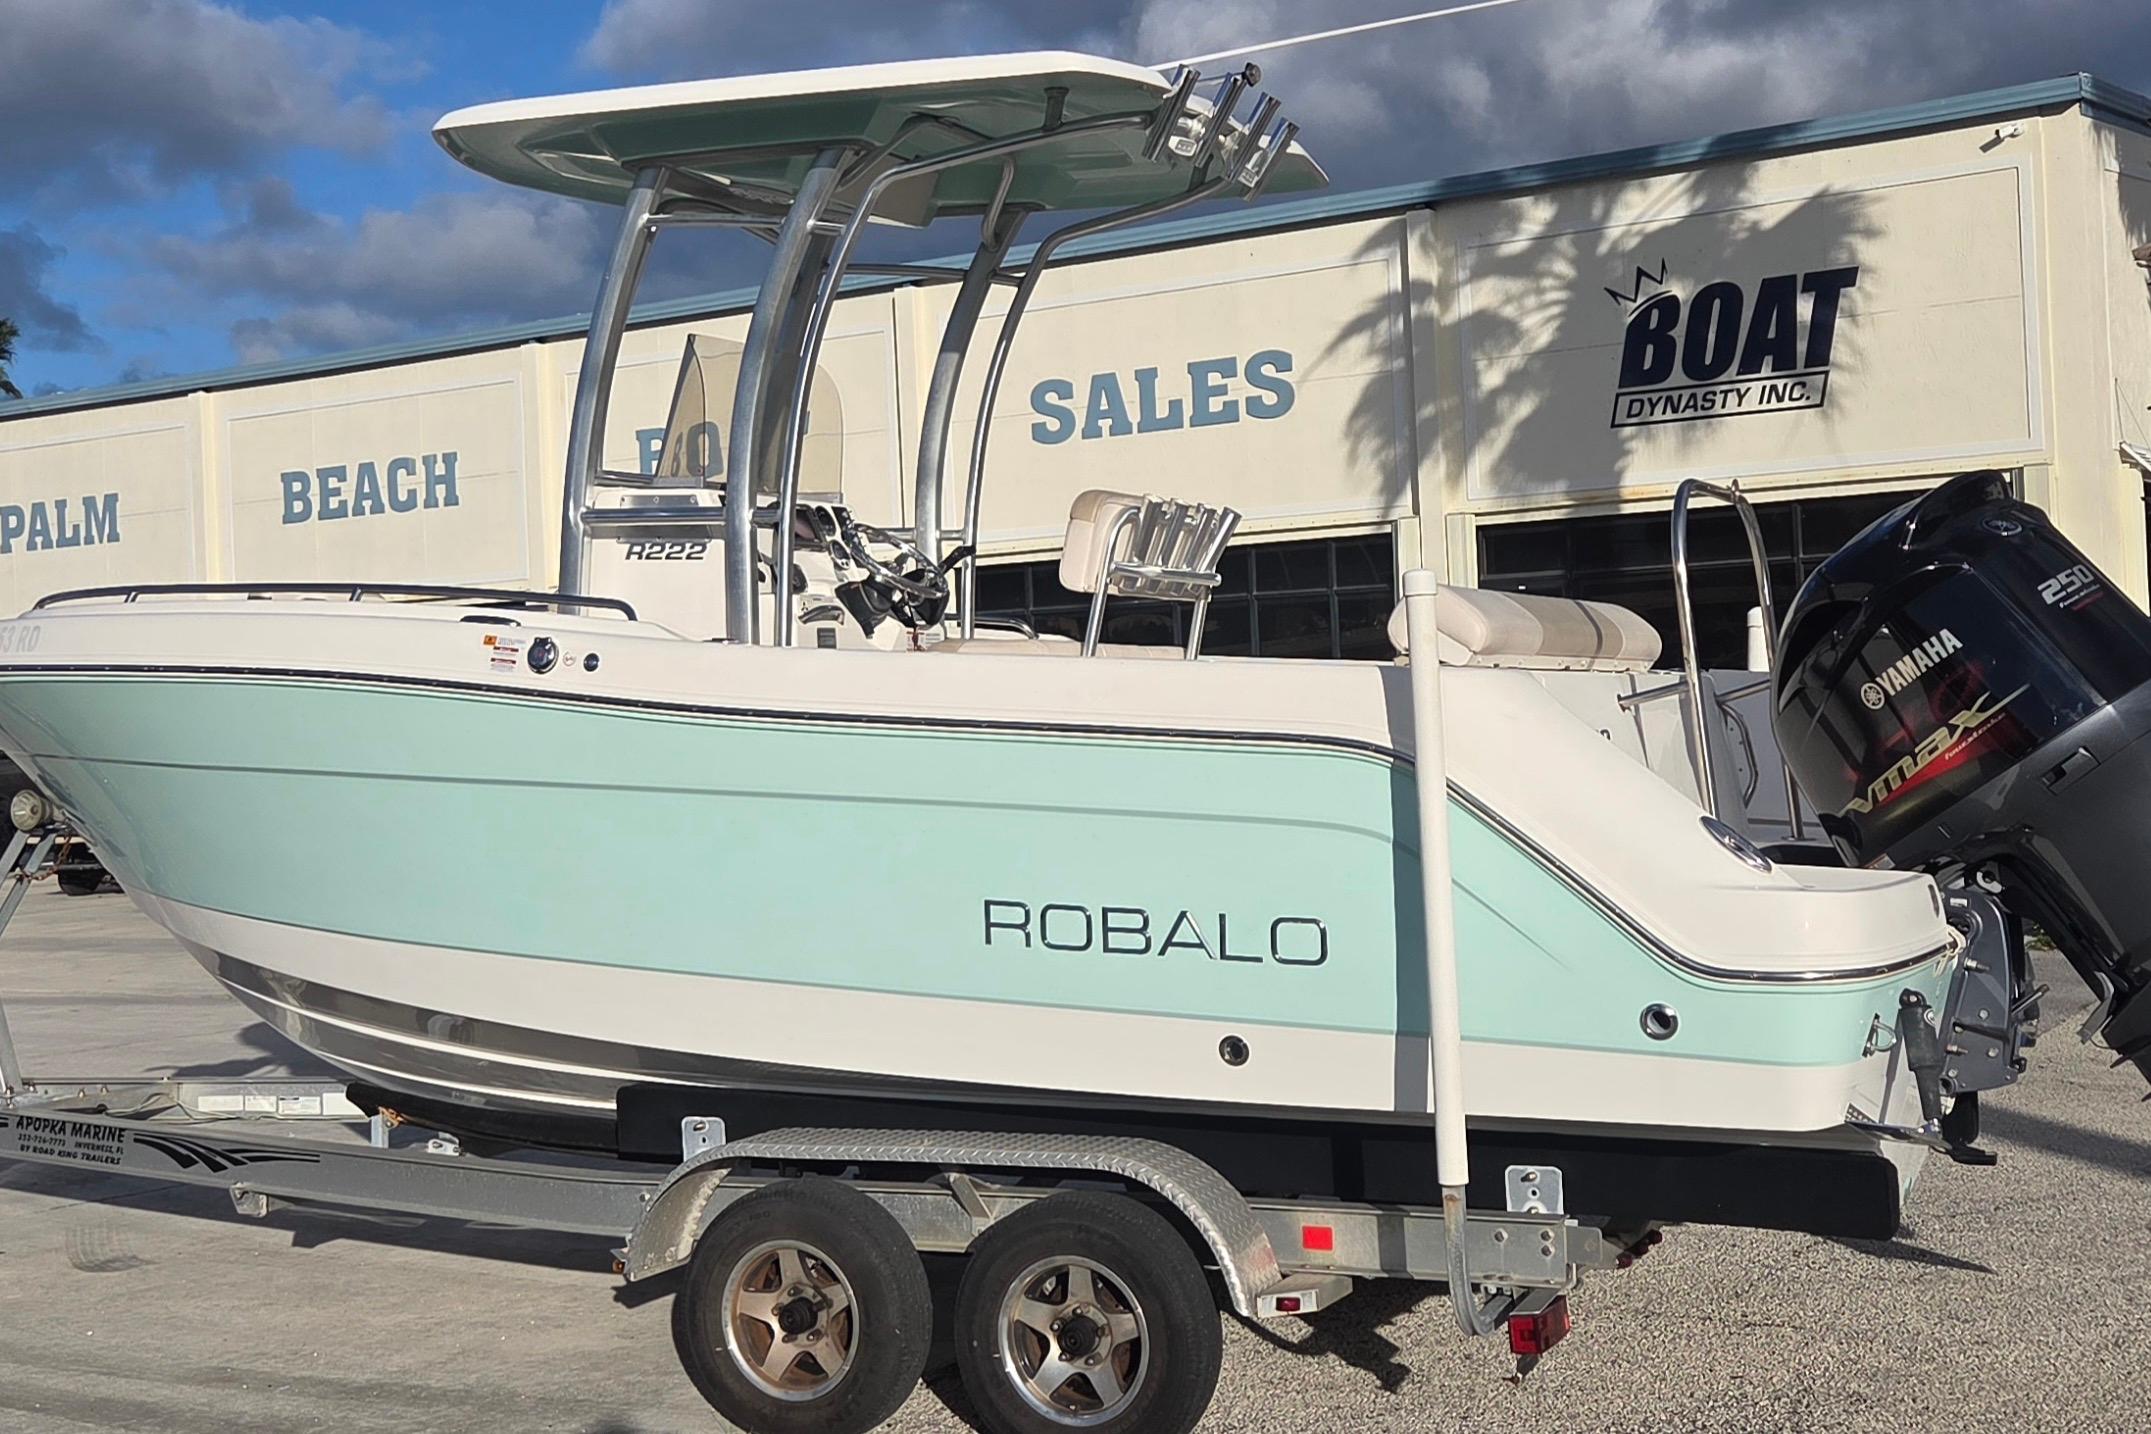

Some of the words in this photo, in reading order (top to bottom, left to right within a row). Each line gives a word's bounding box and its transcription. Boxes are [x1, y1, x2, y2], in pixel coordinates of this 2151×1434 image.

[1618, 266, 1859, 389] BOAT
[1626, 387, 1752, 419] DYNASTY
[1758, 381, 1812, 405] INC.
[0, 492, 120, 554] PALM
[281, 451, 460, 525] BEACH
[1030, 349, 1296, 445] SALES
[625, 541, 708, 560] R222
[2037, 564, 2095, 605] 250
[1876, 628, 1964, 697] YAMAHA
[984, 899, 1329, 967] ROBALO
[16, 1115, 66, 1137] APOPKA
[70, 1121, 127, 1144] MARINE
[32, 1145, 55, 1156] ROAD
[57, 1150, 78, 1160] KING
[80, 1152, 121, 1165] TRAILERS
